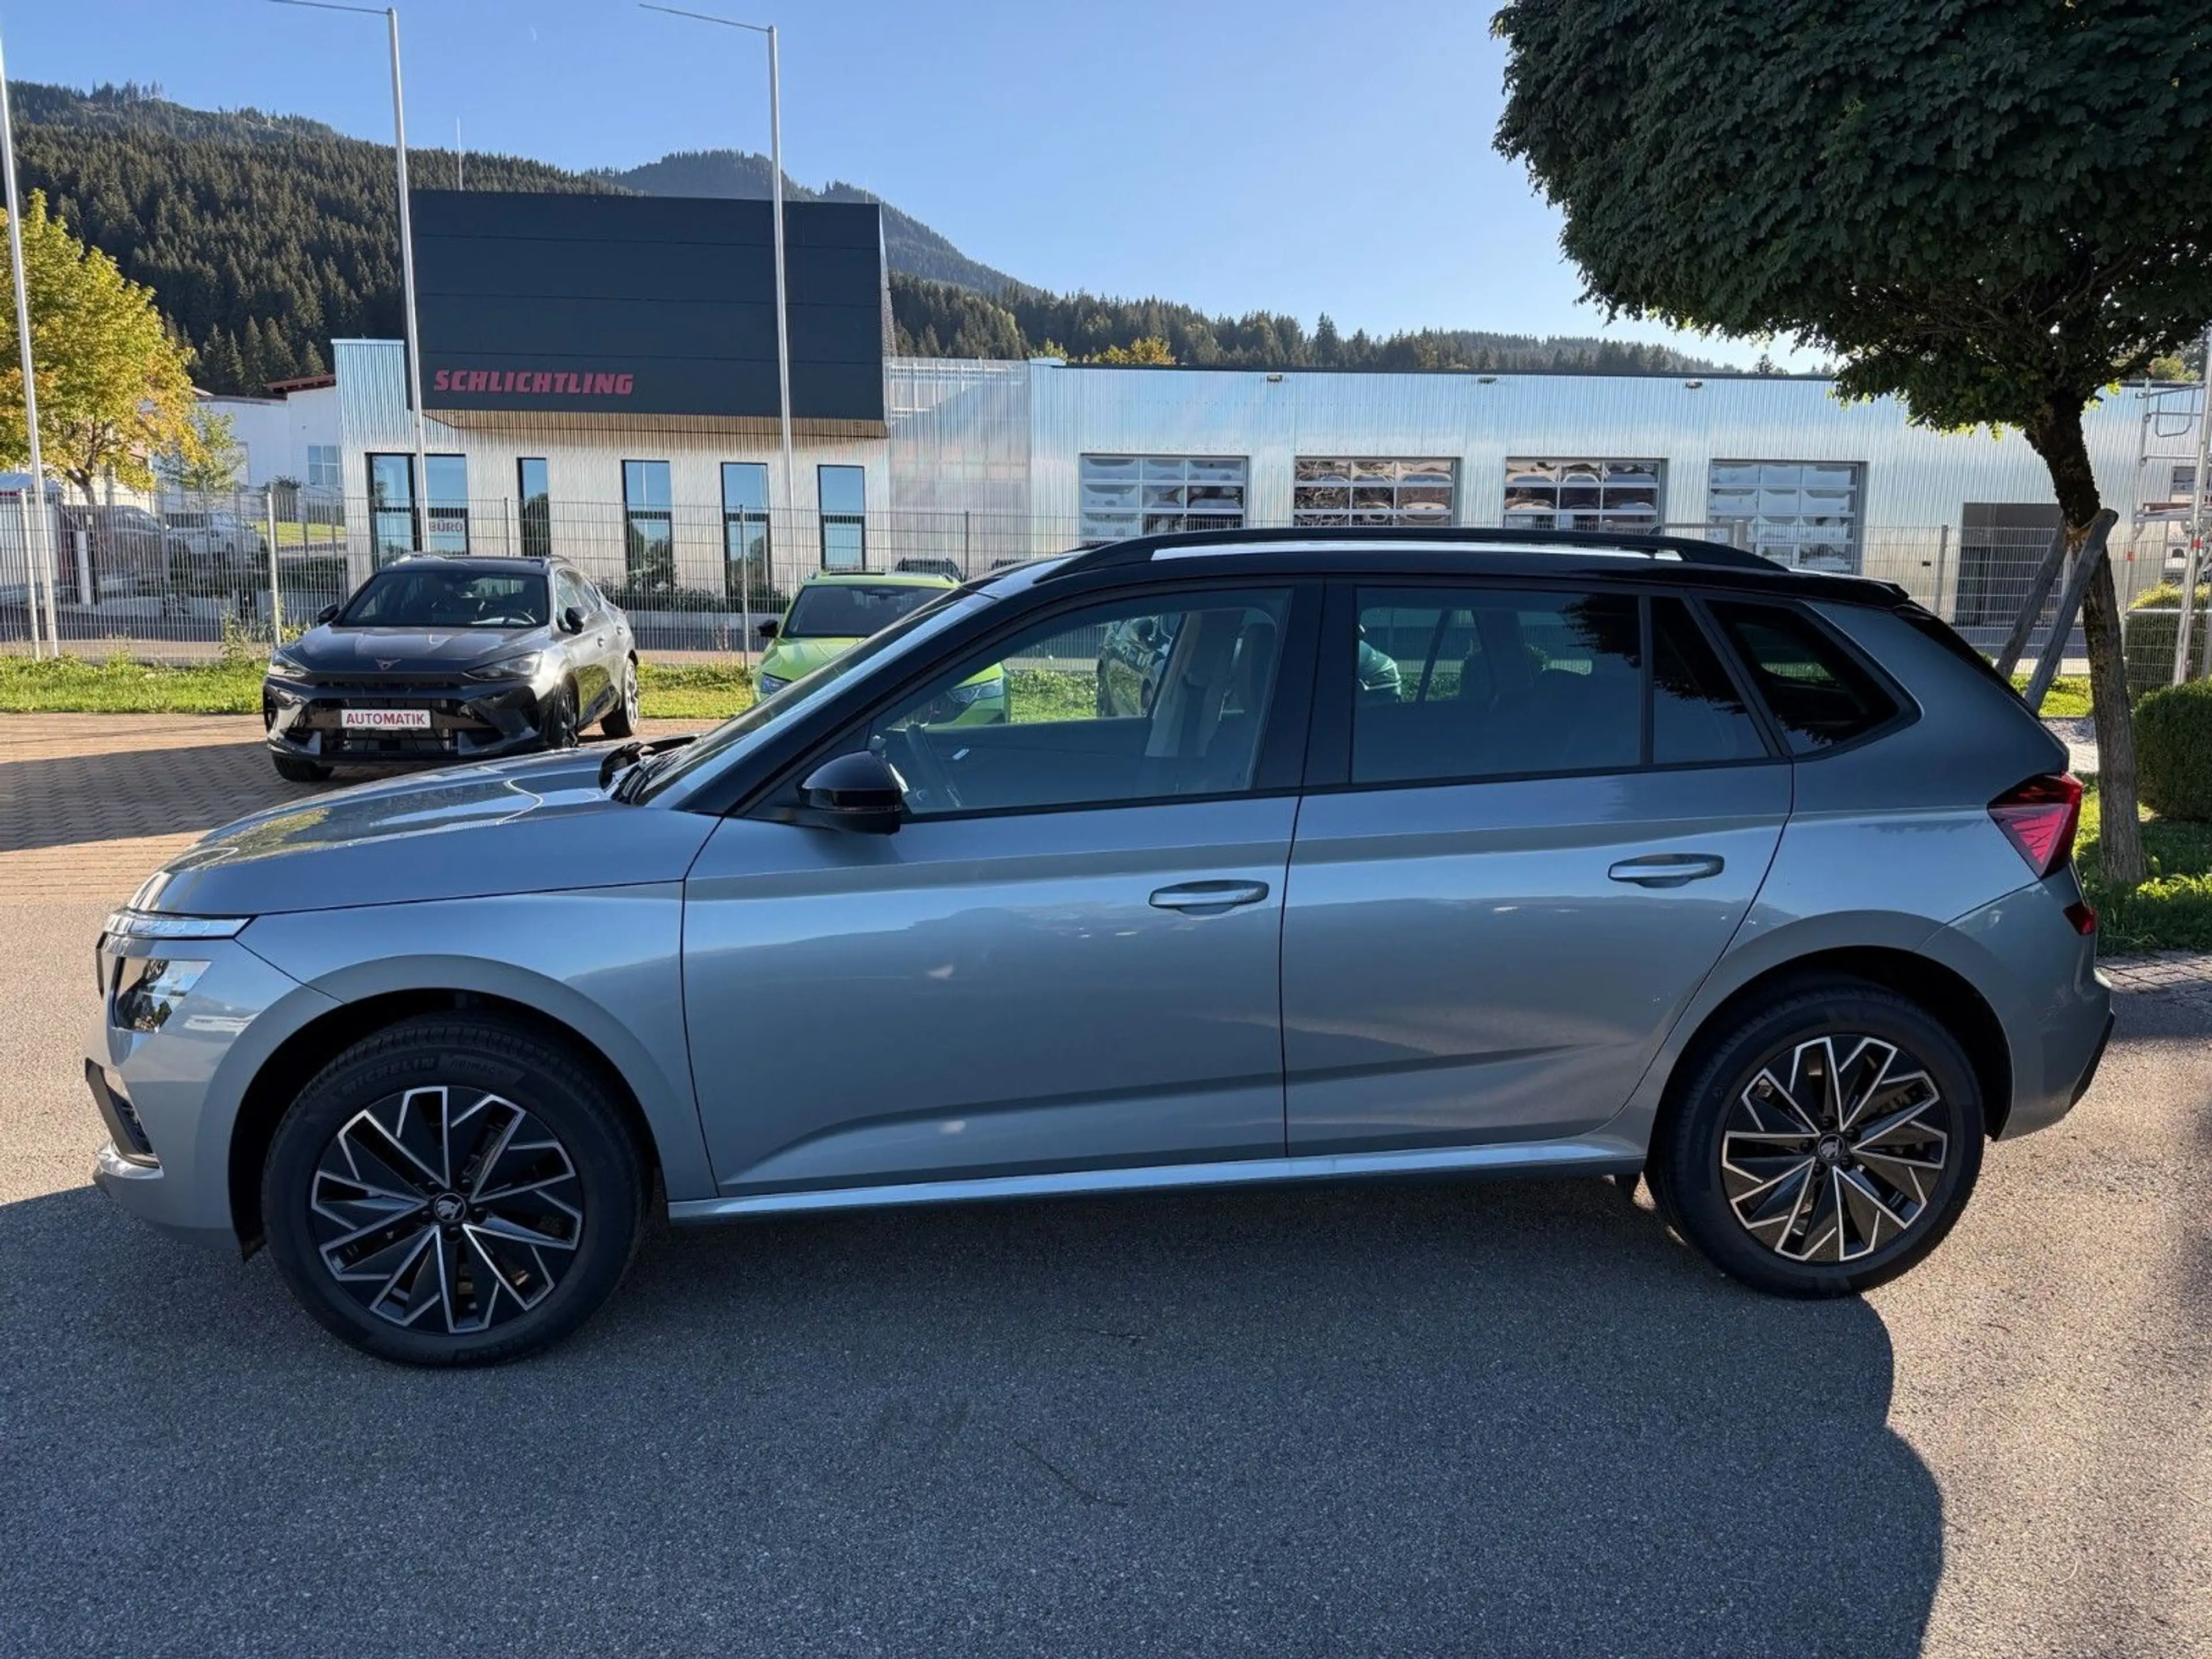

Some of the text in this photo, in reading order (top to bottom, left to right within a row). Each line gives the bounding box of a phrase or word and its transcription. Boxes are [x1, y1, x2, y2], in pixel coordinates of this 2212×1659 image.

[434, 370, 633, 395] SCHLICHTLING
[429, 520, 463, 532] BÜRO
[347, 713, 425, 725] AUTOMATIK
